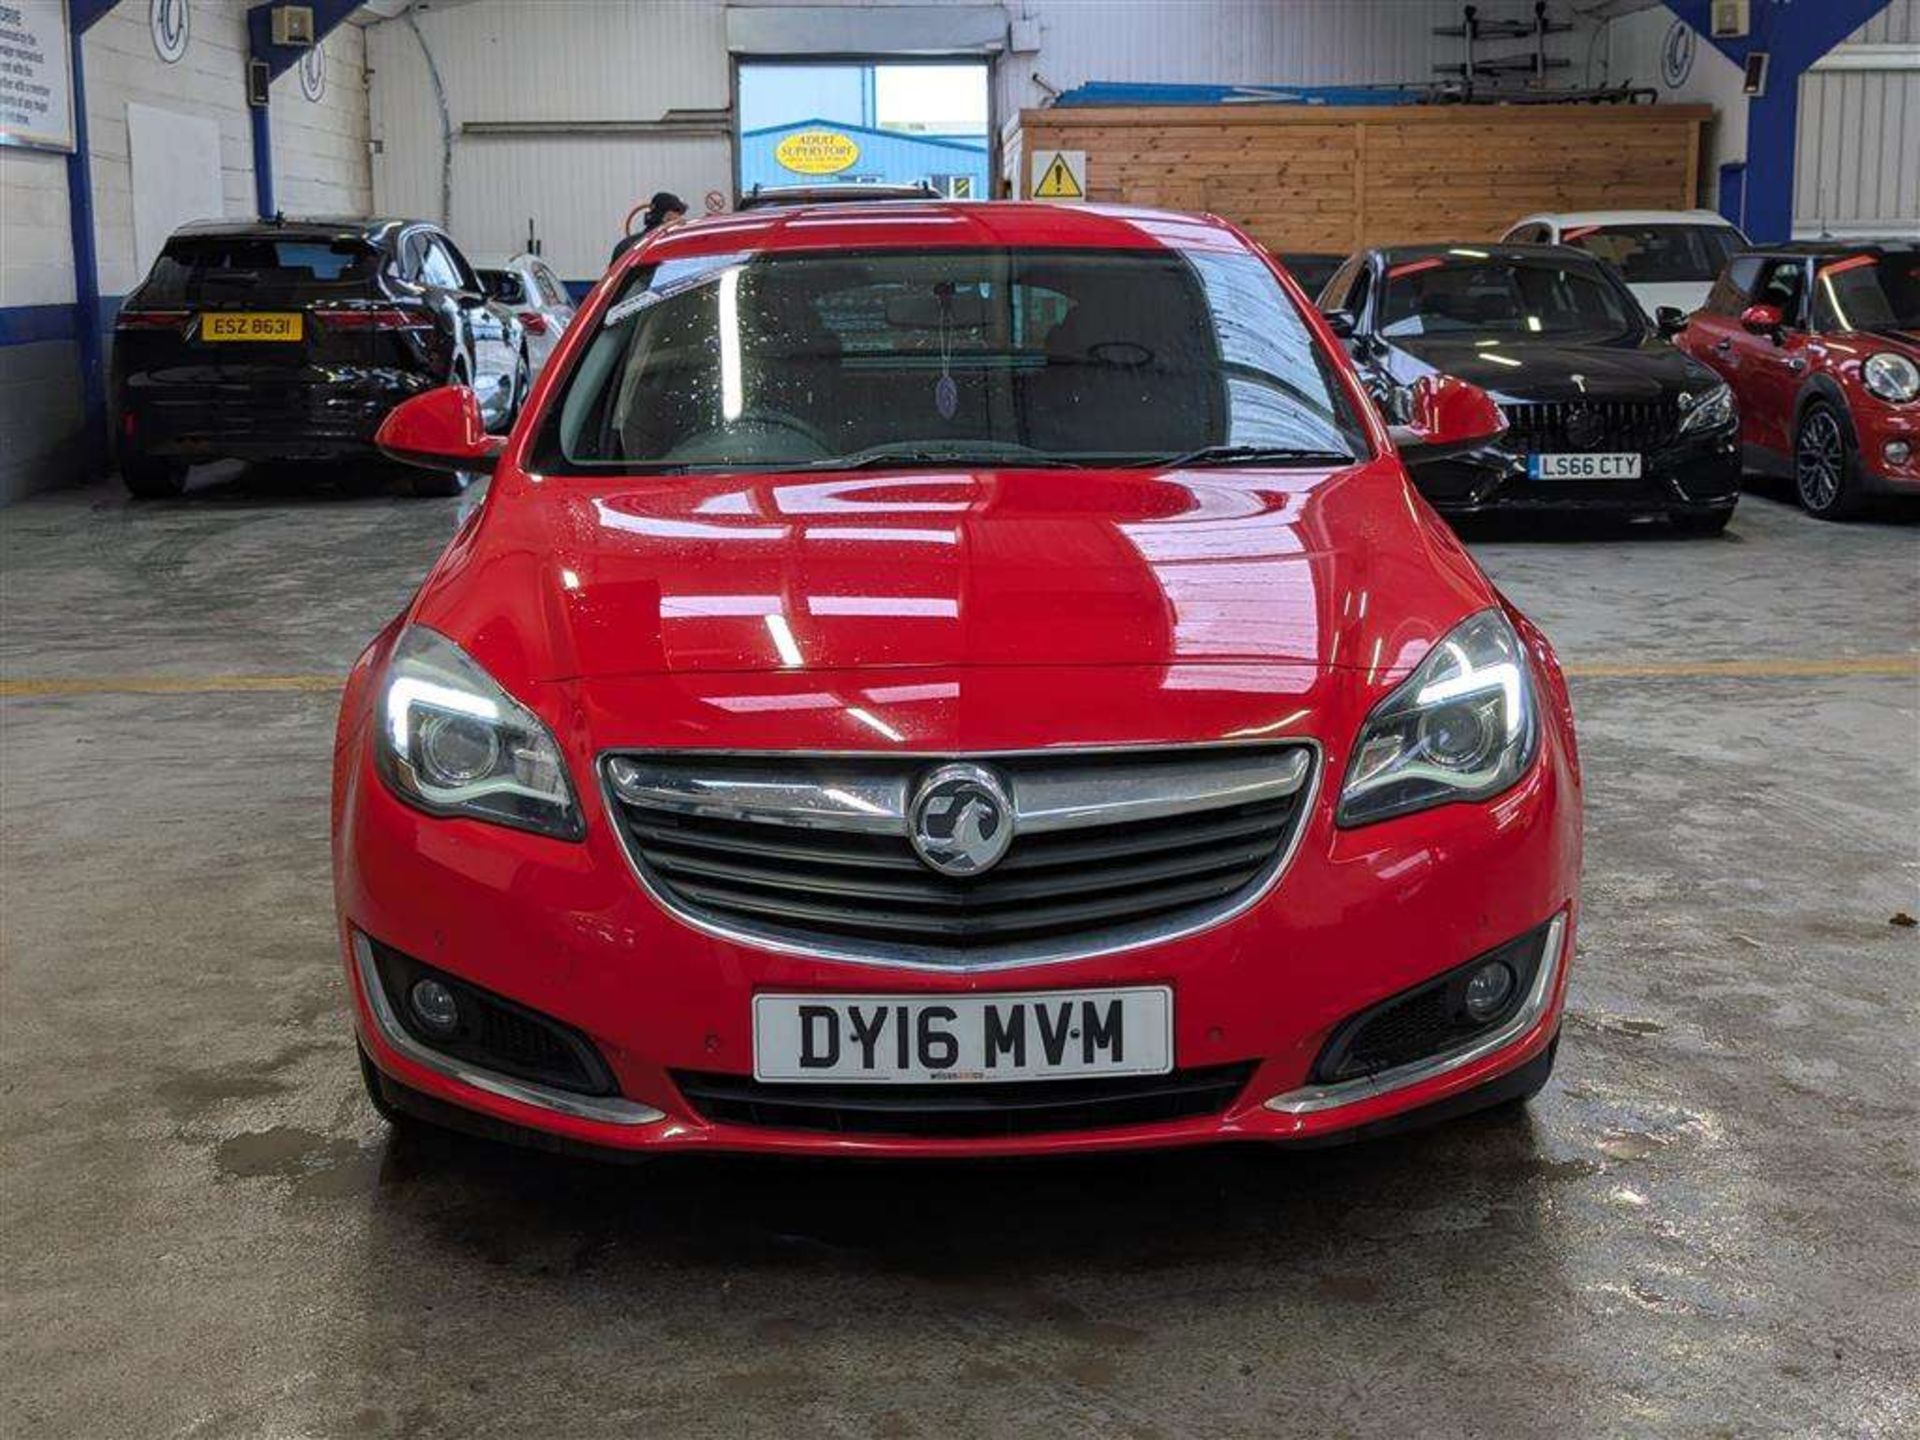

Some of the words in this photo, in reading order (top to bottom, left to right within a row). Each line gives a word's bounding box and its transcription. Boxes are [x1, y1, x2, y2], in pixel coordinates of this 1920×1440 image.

[800, 134, 833, 145] ADULT
[214, 318, 248, 334] ESZ
[252, 318, 290, 334] 8631
[1543, 457, 1594, 475] LS66
[1600, 457, 1637, 474] CTY
[798, 1005, 958, 1069] DY16
[984, 1000, 1123, 1068] MVM
